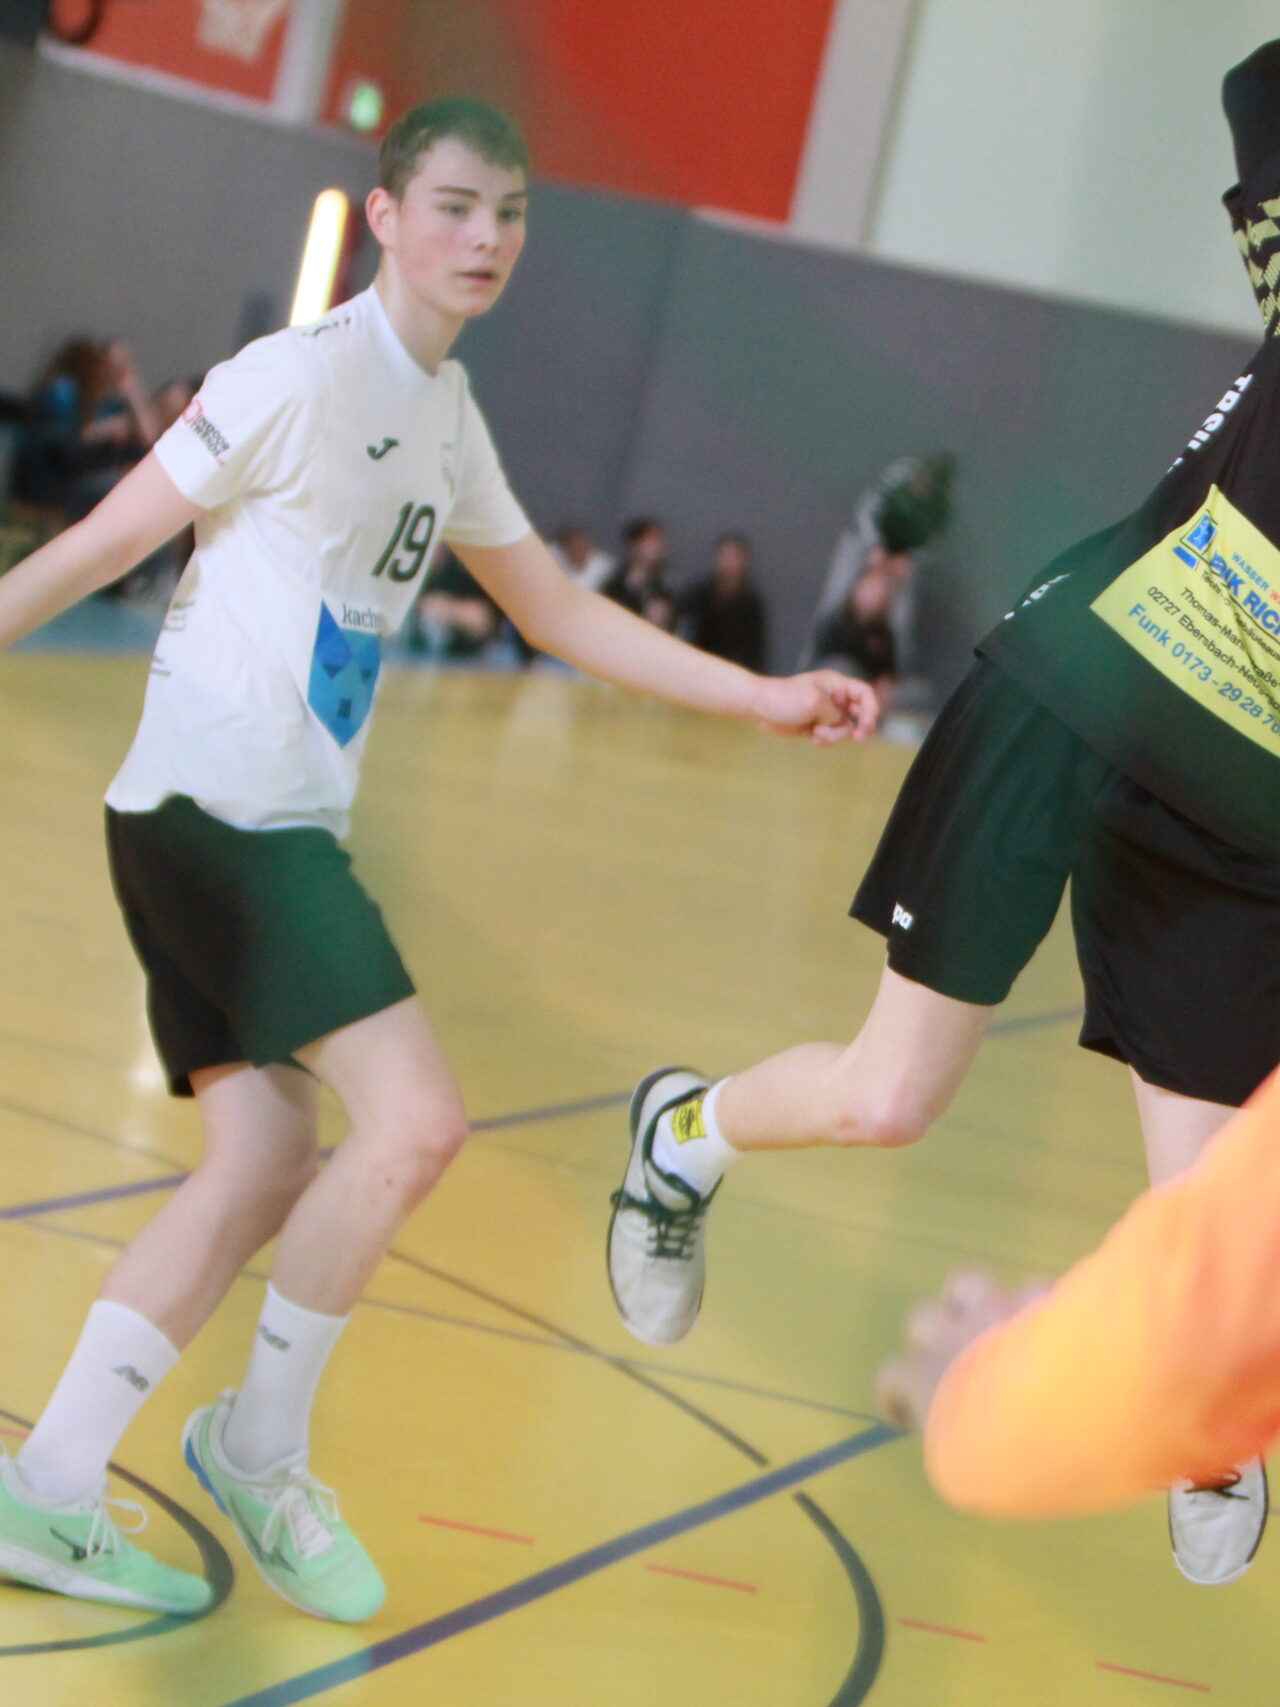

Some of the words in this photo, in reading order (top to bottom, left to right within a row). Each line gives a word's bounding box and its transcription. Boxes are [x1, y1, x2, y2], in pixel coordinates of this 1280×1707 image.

[371, 501, 436, 583] 19
[1232, 552, 1270, 591] WASSER
[1147, 585, 1182, 617] 02727
[1127, 603, 1171, 648] Funk
[1171, 642, 1213, 682] 0173
[1218, 682, 1243, 702] 29
[1239, 696, 1264, 719] 28
